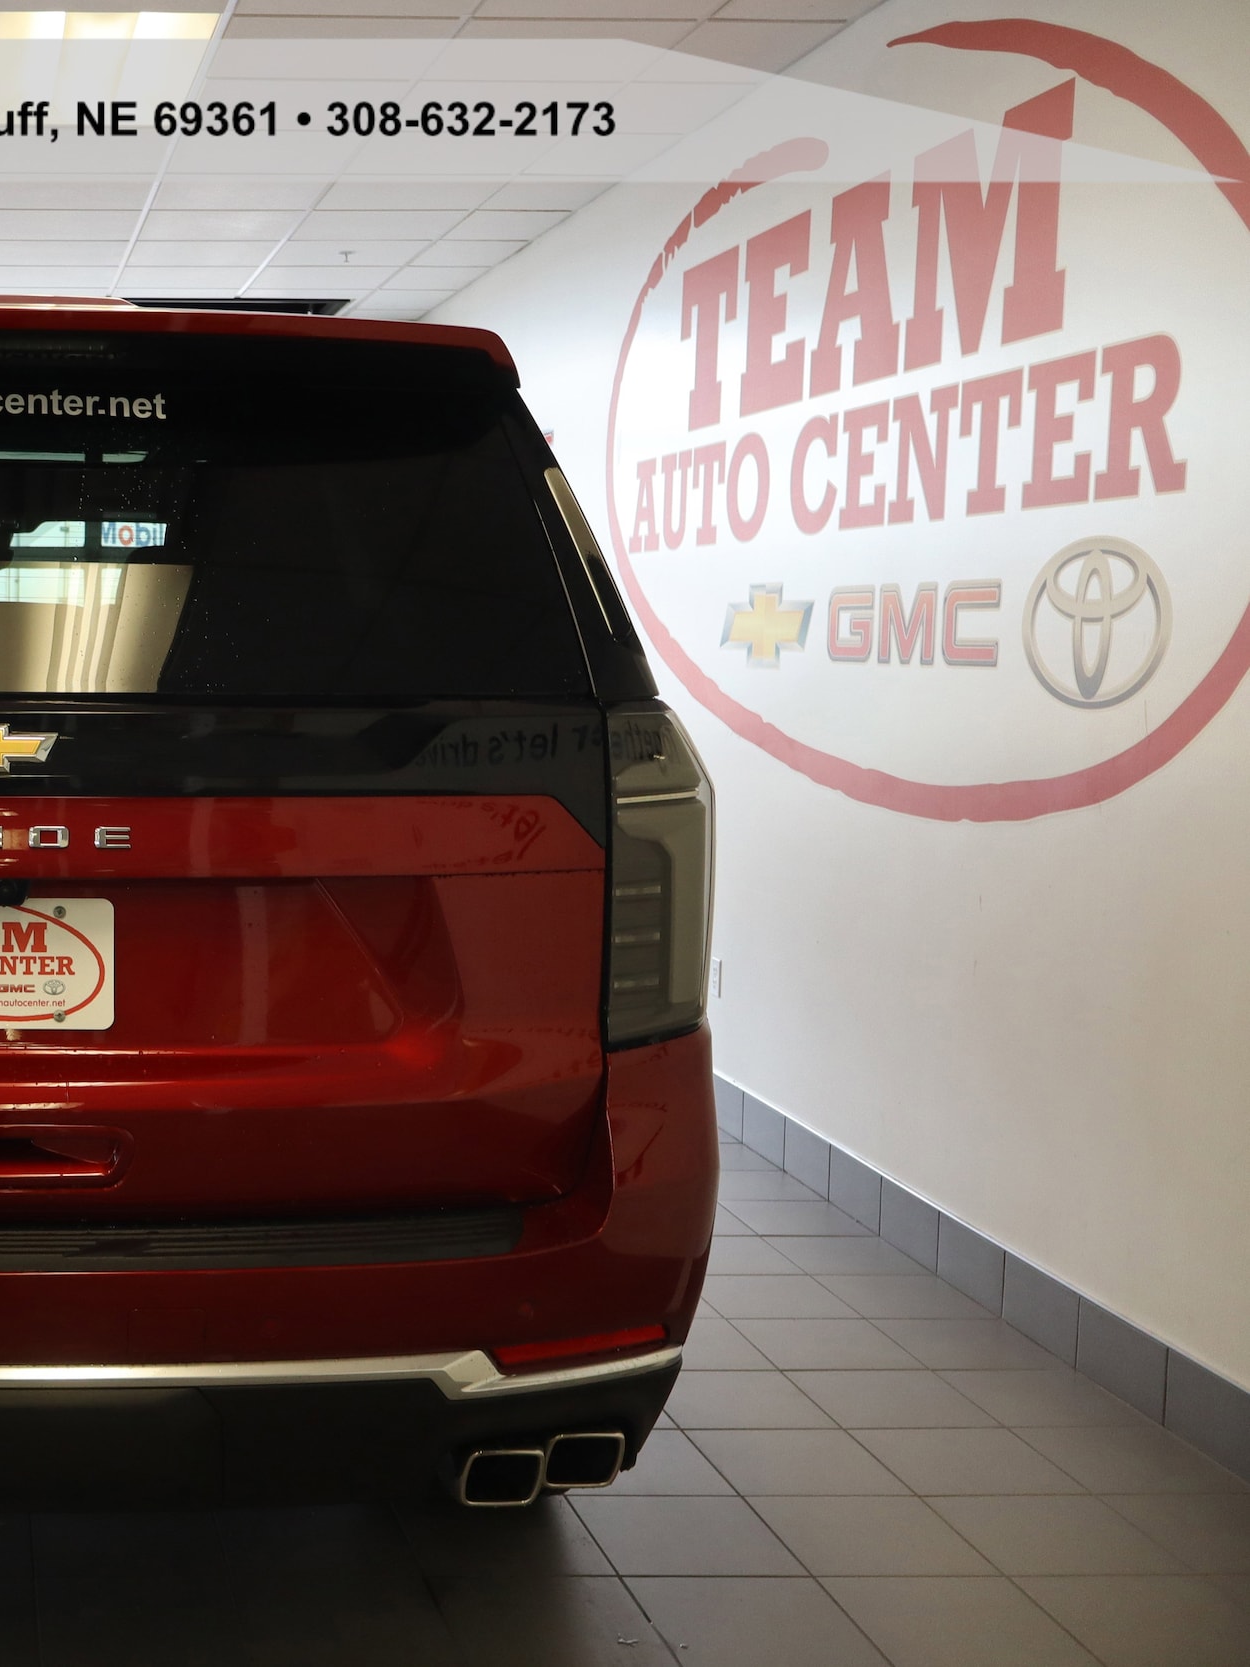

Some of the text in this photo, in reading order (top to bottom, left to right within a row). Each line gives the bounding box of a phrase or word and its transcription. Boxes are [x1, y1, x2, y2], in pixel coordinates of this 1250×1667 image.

[681, 77, 1075, 432] TEAM
[628, 331, 1188, 554] AUTO CENTER
[827, 579, 1002, 667] GMC
